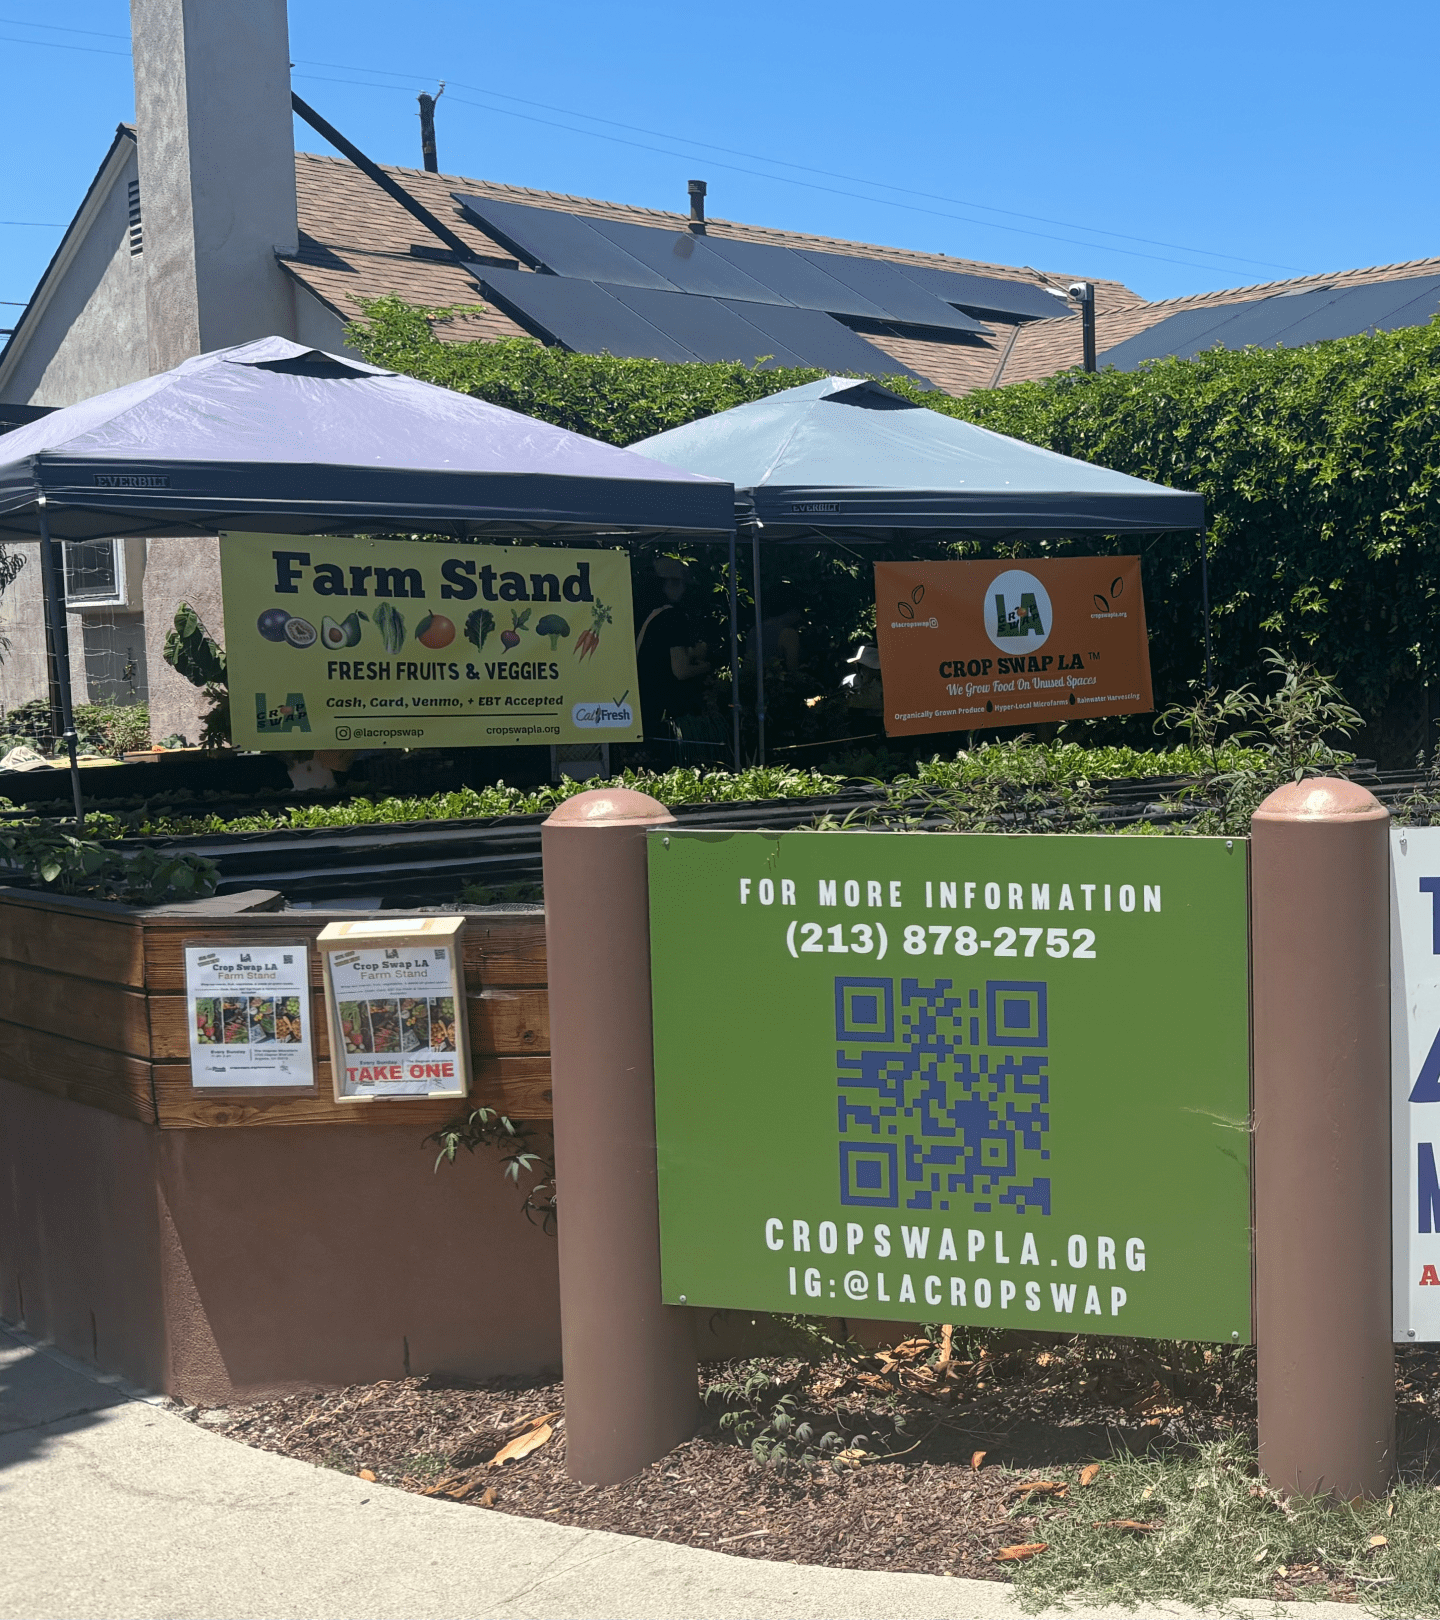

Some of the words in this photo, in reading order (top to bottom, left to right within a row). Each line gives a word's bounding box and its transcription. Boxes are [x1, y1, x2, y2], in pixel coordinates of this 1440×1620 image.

[97, 476, 167, 487] EVERBILT
[272, 551, 425, 598] Farm
[441, 559, 594, 602] Stand
[327, 661, 391, 680] FRESH
[396, 662, 460, 680] FRUITS
[466, 663, 481, 680] &
[485, 661, 559, 680] VEGGIES
[939, 659, 993, 678] CROP
[997, 656, 1054, 675] SWAP
[1058, 653, 1085, 670] LA
[946, 684, 963, 696] We
[966, 682, 990, 698] Grow
[993, 680, 1015, 692] Food
[1017, 678, 1031, 690] On
[1032, 676, 1065, 689] Unused
[1066, 675, 1097, 689] Spaces
[326, 697, 366, 709] Cash,
[370, 697, 409, 709] Card,
[412, 697, 463, 708] Venmo,
[478, 697, 501, 706] EBT
[504, 695, 563, 707] Accepted
[895, 711, 933, 721] Organically
[934, 708, 957, 717] Grown
[958, 706, 985, 715] Produce
[1033, 699, 1068, 708] Microfarms
[1107, 693, 1140, 701] Harvesting
[353, 728, 424, 738] @lacropswap
[486, 725, 560, 735] cropswapla.org
[740, 878, 796, 905] FOR
[819, 880, 901, 907] MORE
[926, 881, 1161, 912] INFORMATION
[786, 920, 888, 960] (213)
[903, 925, 1096, 959] 878-2752
[212, 964, 234, 972] Crop
[236, 964, 262, 972] Swap
[353, 962, 379, 971] Crop
[382, 961, 412, 969] Swap
[414, 959, 430, 967] LA
[360, 971, 391, 980] Farm
[395, 969, 428, 978] Stand
[218, 972, 244, 980] Farm
[247, 971, 276, 980] Stand
[346, 1065, 402, 1081] TAKE
[409, 1063, 454, 1078] ONE
[765, 1217, 1146, 1272] CROPSWAPLA.ORG
[1419, 1264, 1440, 1285] A
[789, 1267, 1127, 1316] IG:@LACROPSWAP
